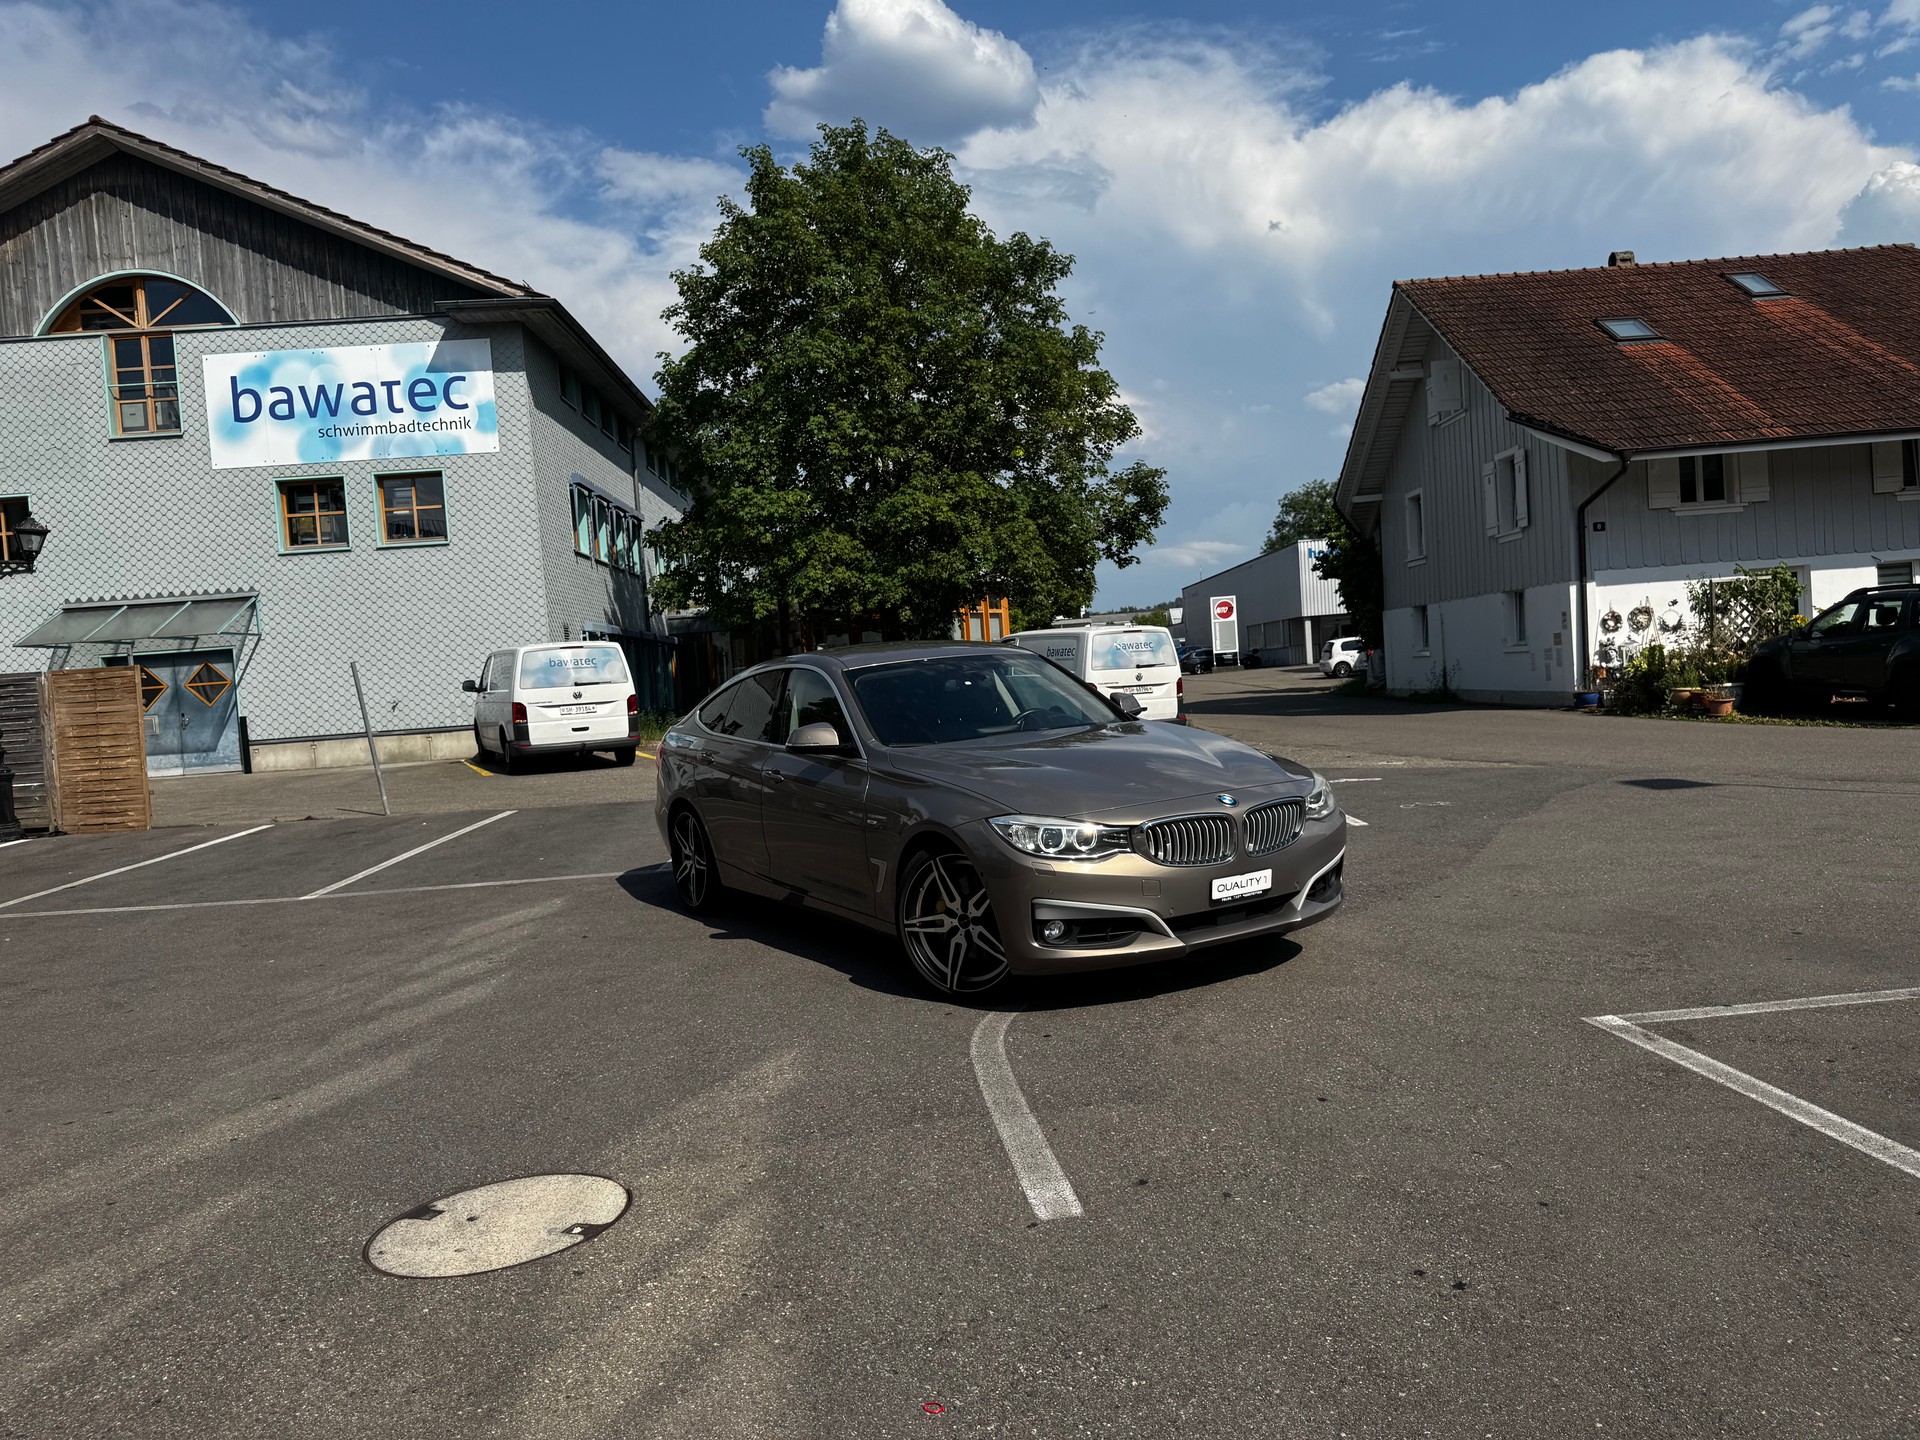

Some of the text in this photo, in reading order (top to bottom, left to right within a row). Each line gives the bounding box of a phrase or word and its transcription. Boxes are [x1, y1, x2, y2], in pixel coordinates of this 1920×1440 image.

[229, 374, 470, 424] bawatec
[318, 416, 472, 439] schwimmbadtechnik
[1046, 646, 1076, 657] bawatec
[548, 657, 597, 667] bawatec
